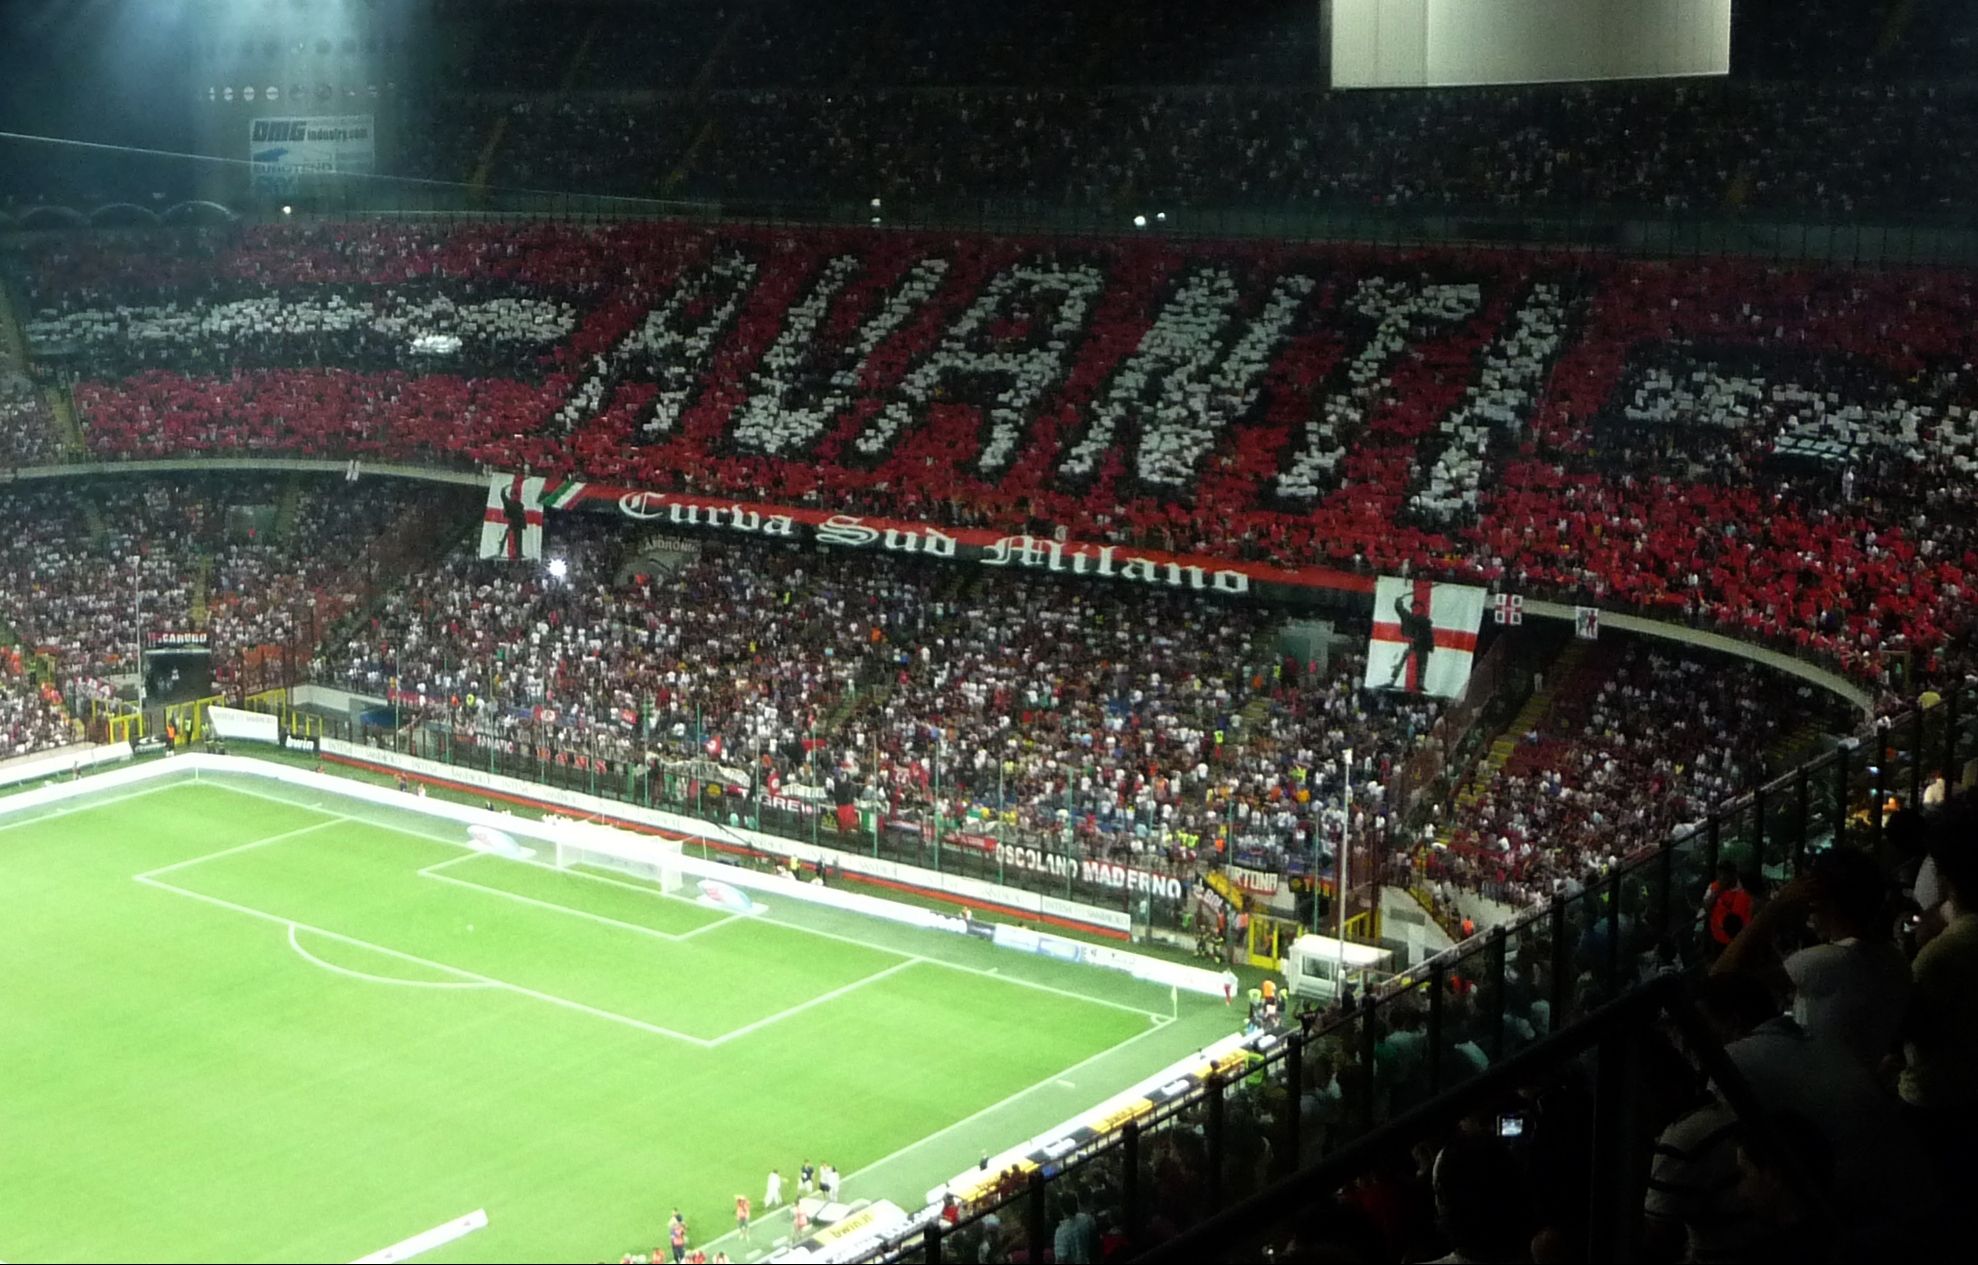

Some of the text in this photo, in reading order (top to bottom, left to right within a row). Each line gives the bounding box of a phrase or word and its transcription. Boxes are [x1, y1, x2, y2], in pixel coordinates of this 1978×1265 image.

[252, 121, 307, 141] DMG
[618, 491, 1248, 593] Curva Sud Milano
[285, 734, 314, 750] bwin
[988, 842, 1182, 899] OSCOLANO MADERNO
